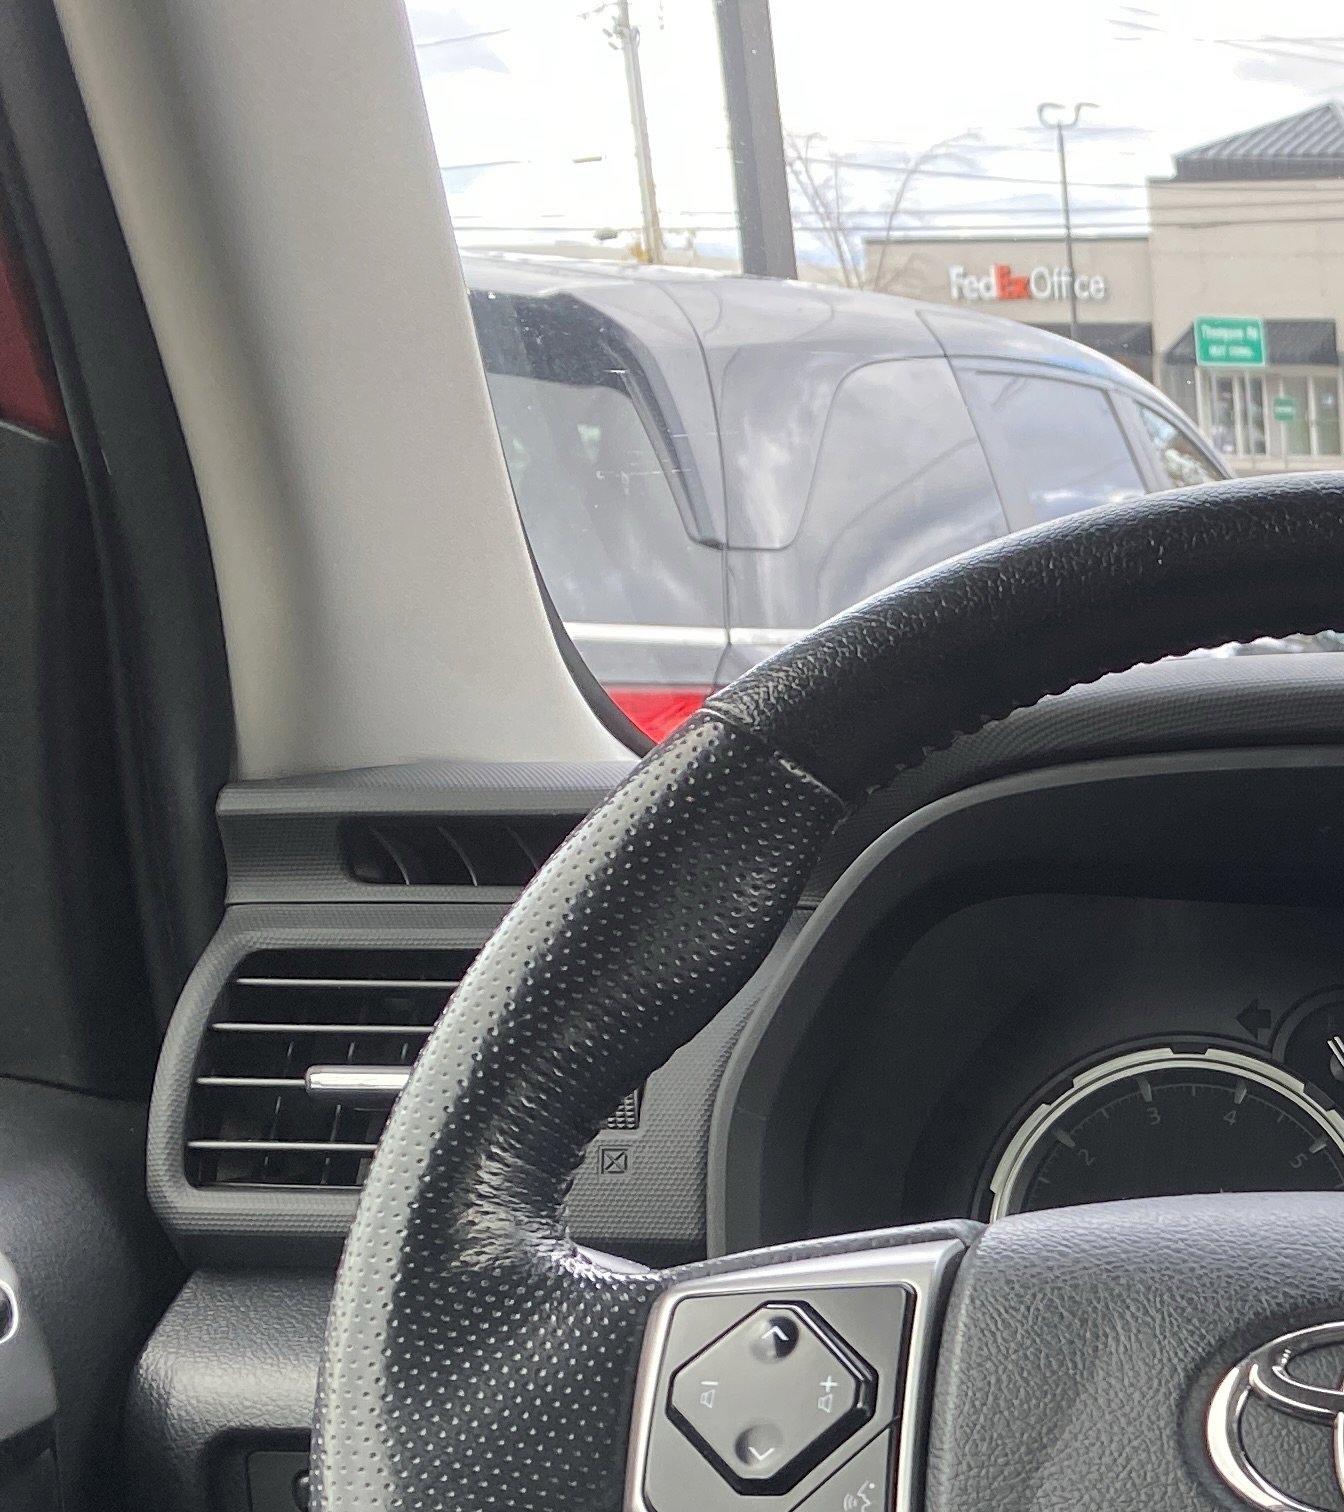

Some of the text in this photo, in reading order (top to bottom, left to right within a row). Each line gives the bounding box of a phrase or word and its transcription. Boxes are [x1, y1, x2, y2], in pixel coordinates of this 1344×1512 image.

[949, 264, 1106, 299] FedEx Offce
[1147, 1106, 1161, 1126] 3
[1223, 1109, 1238, 1126] 4
[1077, 1148, 1096, 1167] 2
[1288, 1152, 1310, 1170] 5
